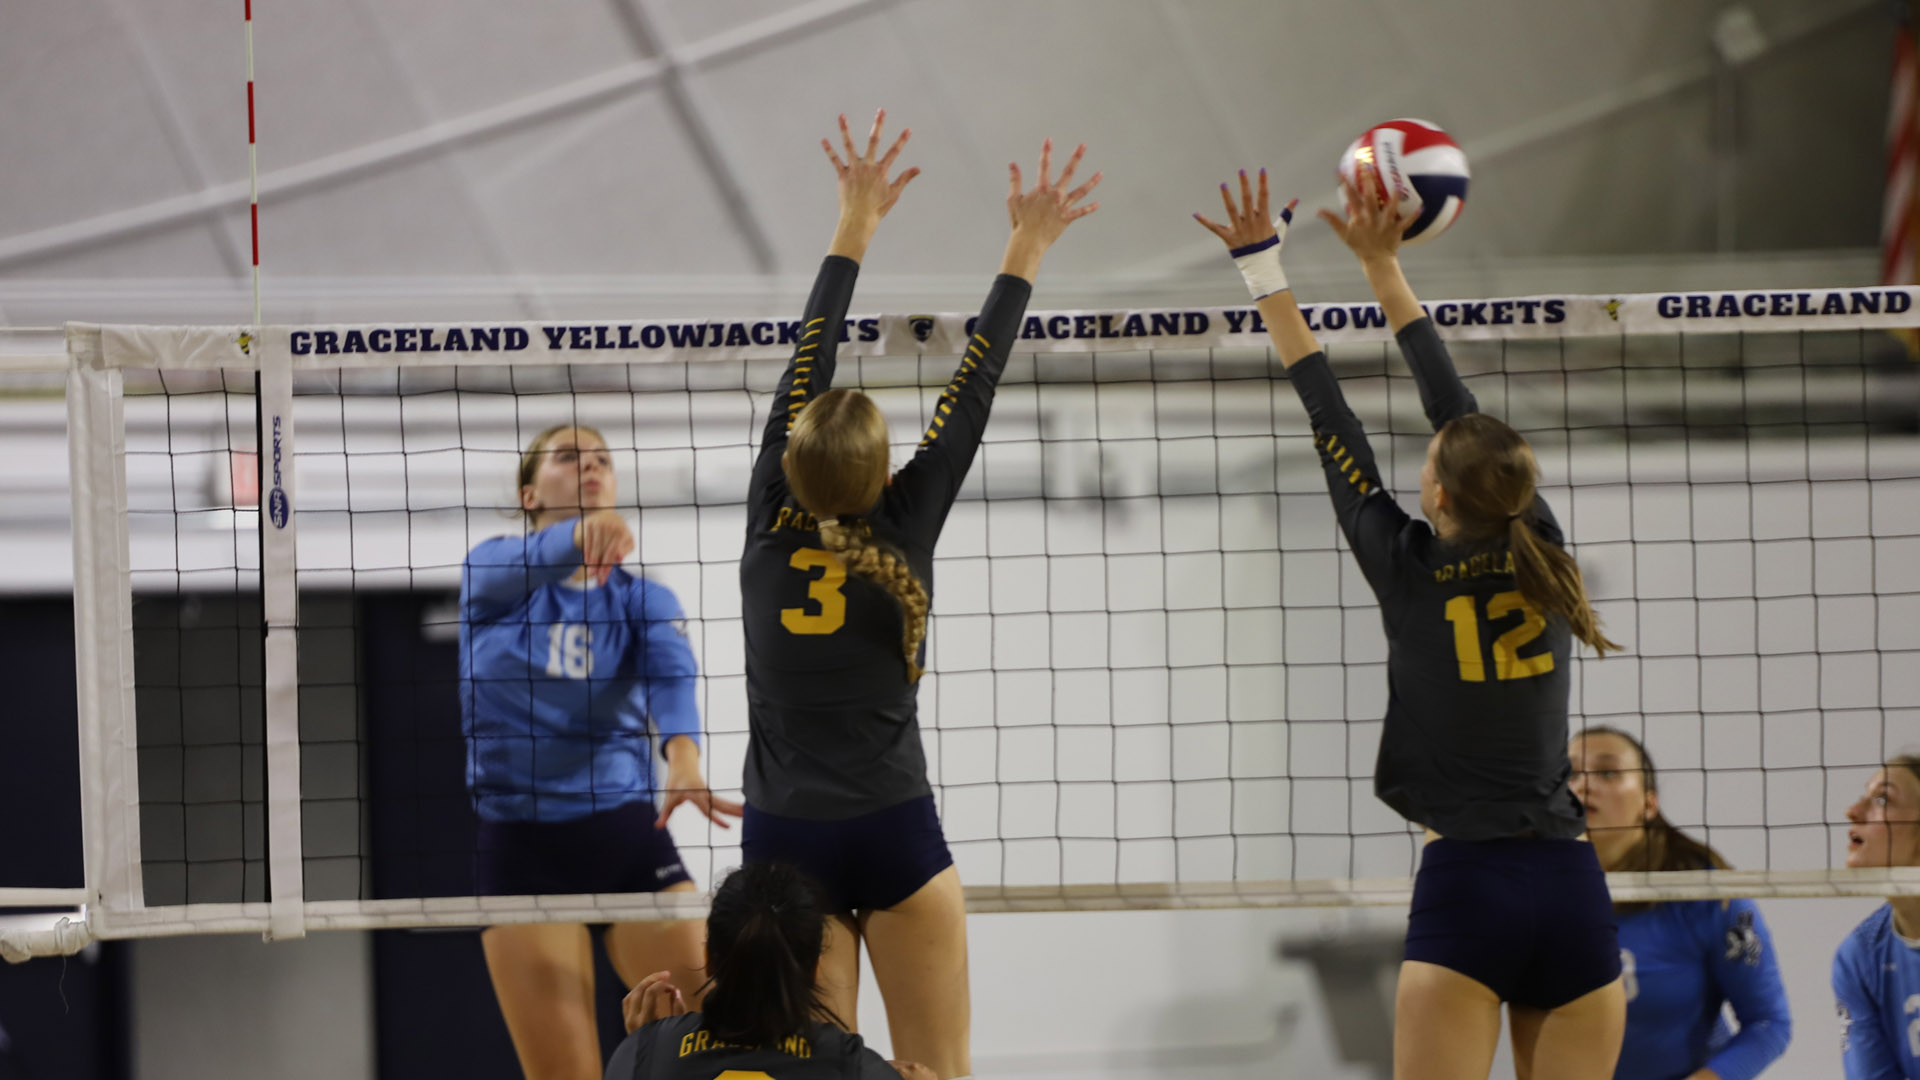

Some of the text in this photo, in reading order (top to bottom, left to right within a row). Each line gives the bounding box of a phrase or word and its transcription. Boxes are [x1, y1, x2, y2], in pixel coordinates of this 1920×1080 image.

[965, 313, 1209, 340] GACELAND
[1657, 291, 1912, 319] GRACELAND
[290, 318, 880, 355] GRACELAND YELLOWJACKTS
[273, 415, 282, 488] SPORTS
[780, 547, 847, 635] 3
[546, 621, 594, 681] 16
[1445, 590, 1555, 682] 12
